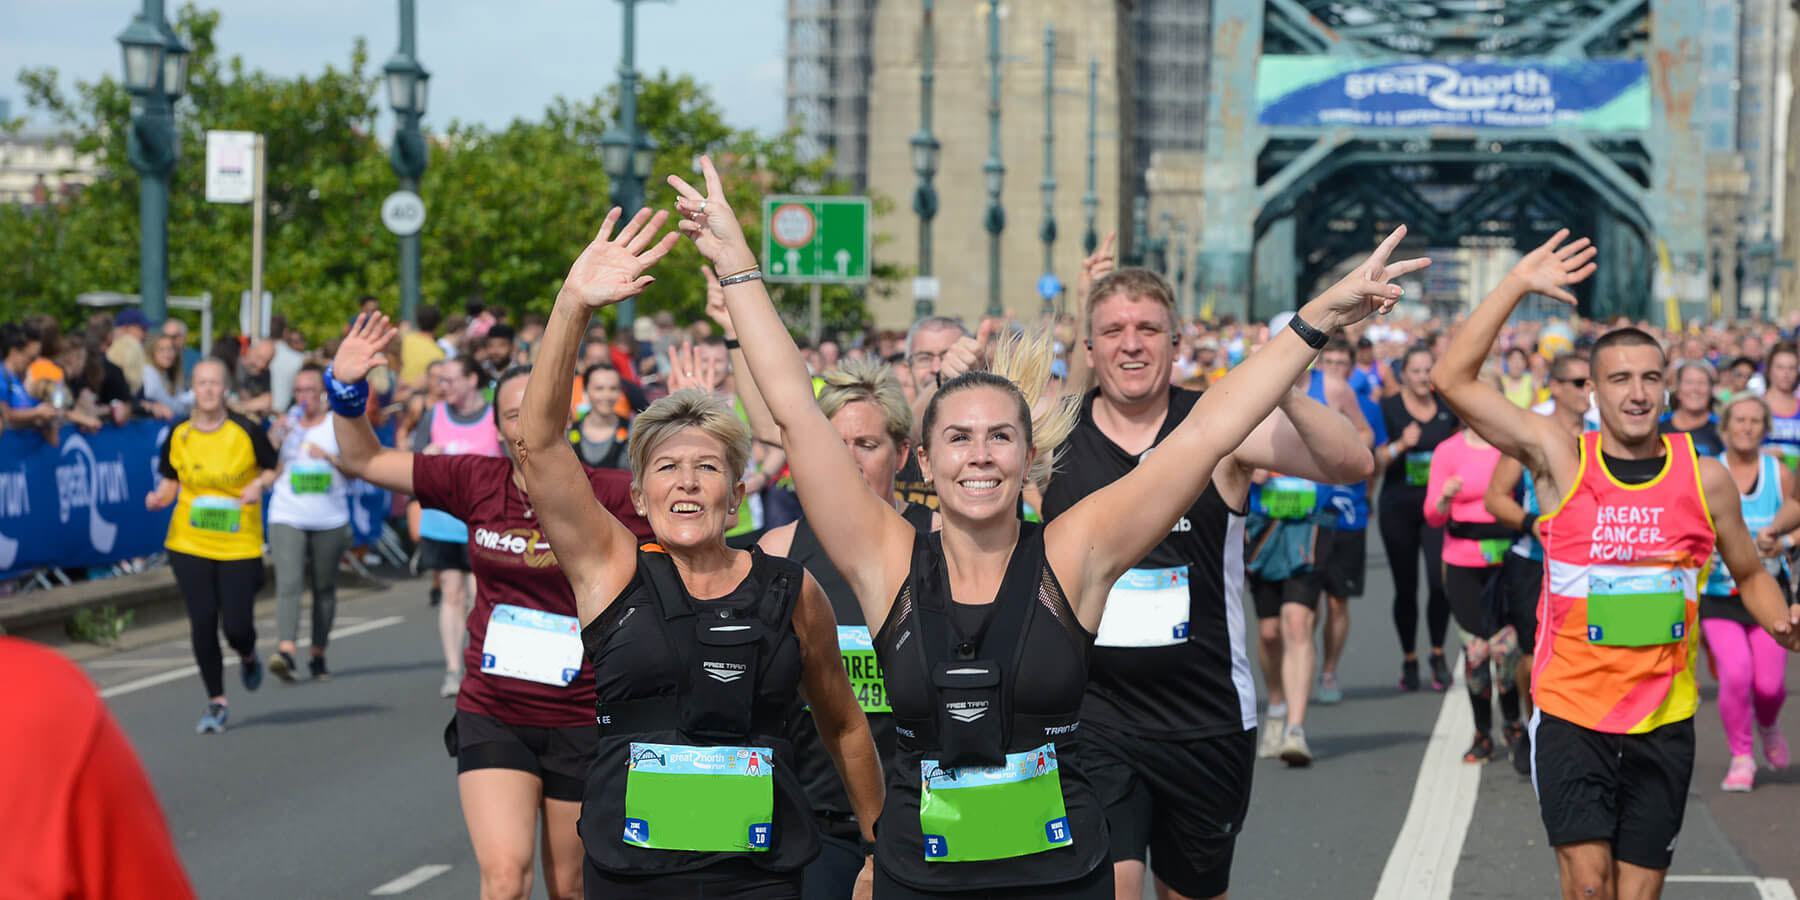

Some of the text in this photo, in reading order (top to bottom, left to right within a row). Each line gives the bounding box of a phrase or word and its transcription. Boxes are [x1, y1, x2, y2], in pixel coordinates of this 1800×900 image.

[1345, 69, 1550, 99] great north
[1500, 95, 1555, 112] run
[391, 205, 418, 220] 40
[1597, 506, 1665, 525] BREAST
[1591, 526, 1667, 544] CANCER
[1589, 543, 1633, 560] NOW
[1044, 724, 1071, 736] TRAIN
[669, 751, 692, 763] great
[701, 753, 725, 763] north
[756, 834, 766, 844] 10
[1053, 829, 1064, 840] 10
[931, 844, 938, 854] C
